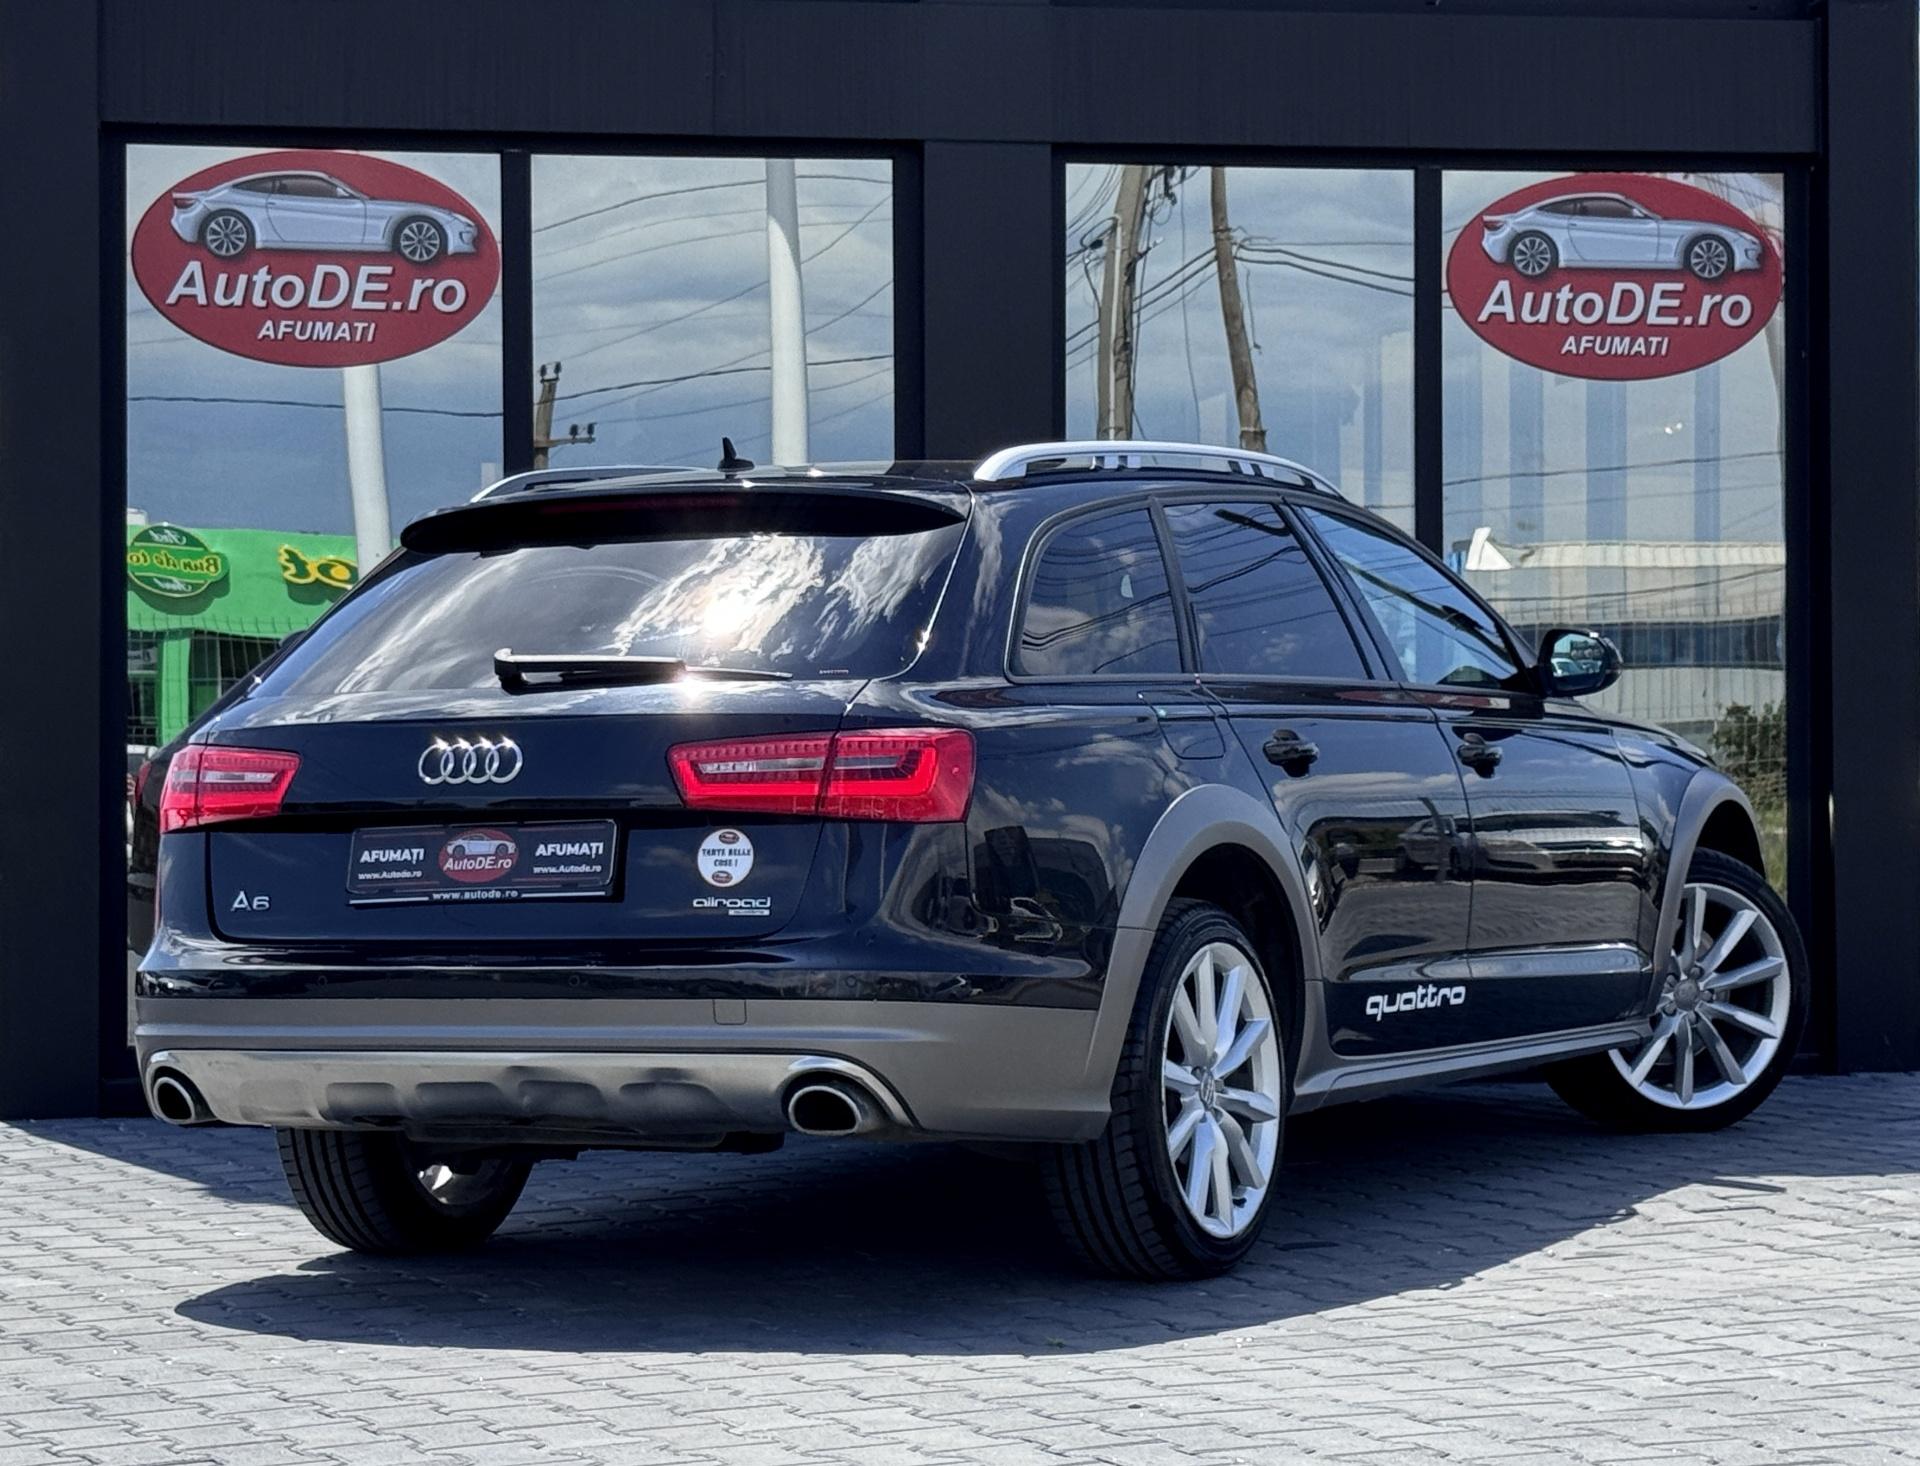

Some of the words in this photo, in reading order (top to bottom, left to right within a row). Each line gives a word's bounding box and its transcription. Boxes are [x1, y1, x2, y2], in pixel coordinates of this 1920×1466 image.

[165, 260, 468, 313] AutoDE.ro
[1477, 279, 1753, 327] AutoDE.ro
[257, 319, 376, 343] AFUMATI
[1560, 335, 1670, 357] AFUMATI
[442, 856, 512, 871] AutoDE.ro
[230, 890, 270, 912] A6
[432, 890, 518, 900] www.autode.ro
[692, 896, 771, 908] allroad
[1365, 983, 1467, 1022] quattro
